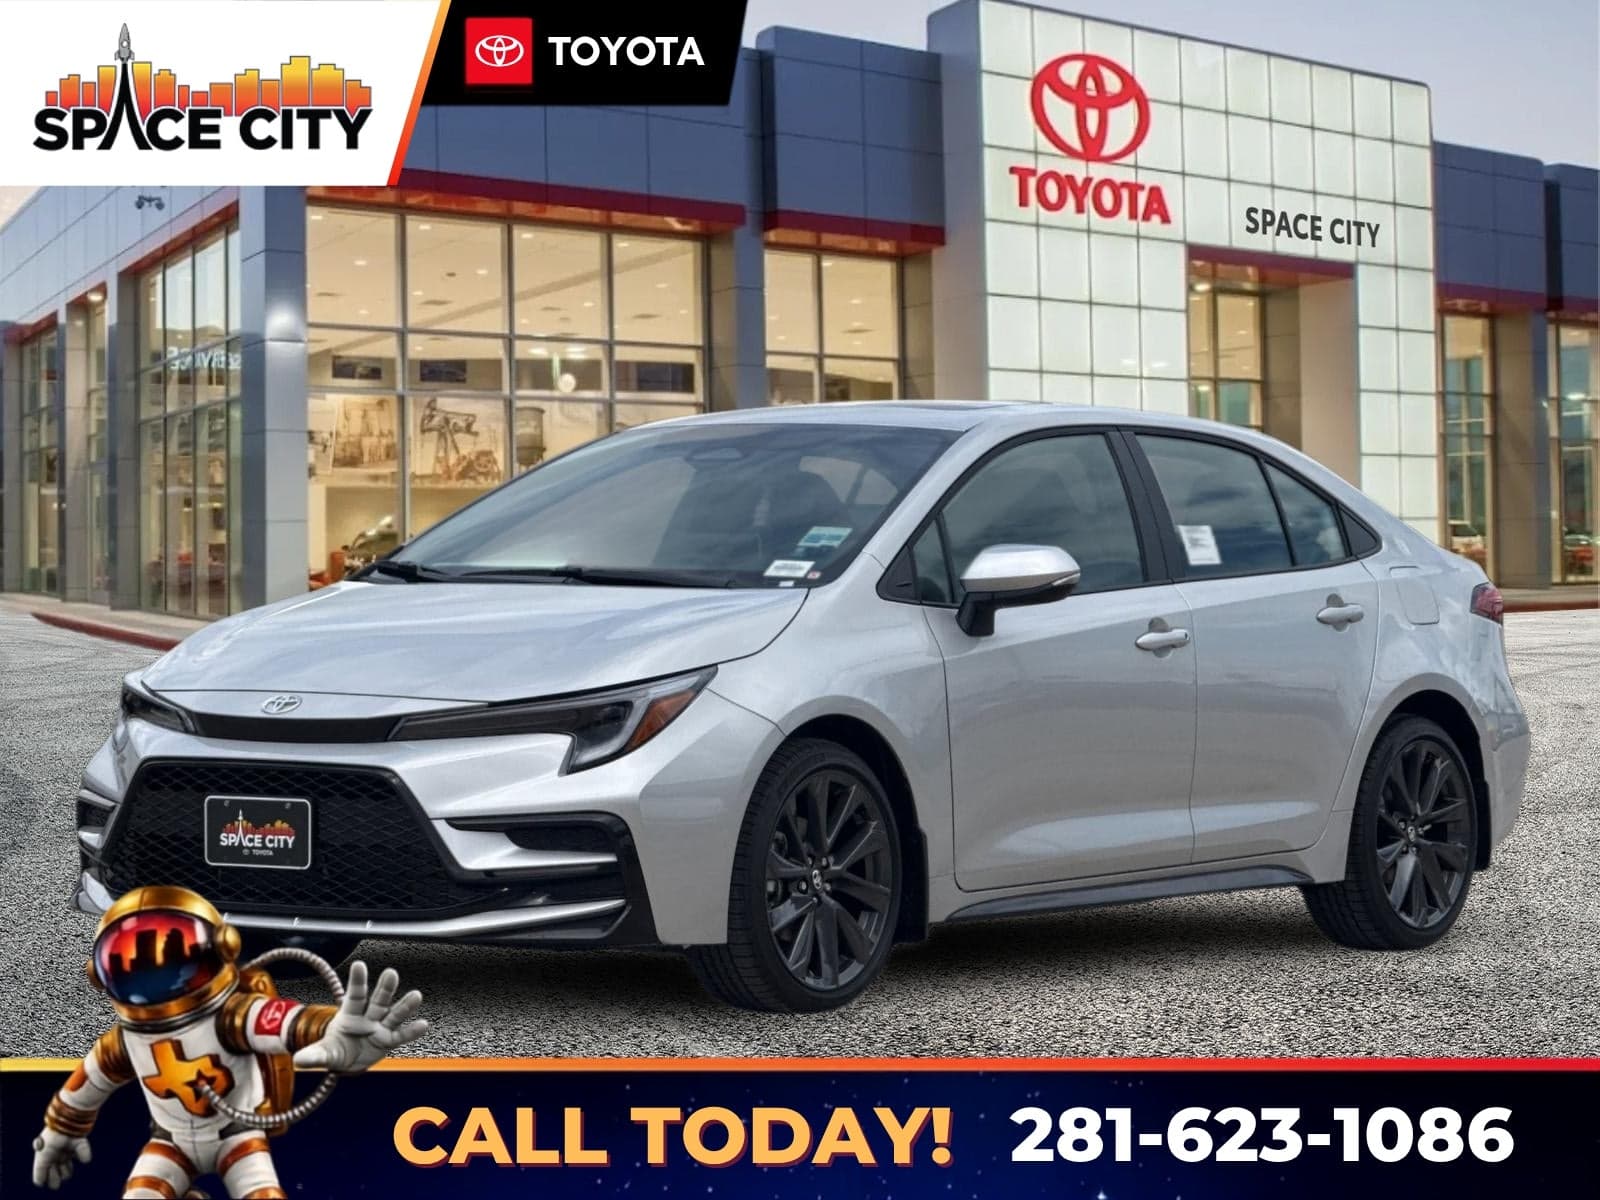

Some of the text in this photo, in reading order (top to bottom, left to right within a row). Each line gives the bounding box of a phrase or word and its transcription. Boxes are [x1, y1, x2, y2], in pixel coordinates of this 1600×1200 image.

[1009, 166, 1171, 224] TOYOTA
[1245, 206, 1381, 248] SPACE CITY
[219, 822, 296, 849] SPACE CITY
